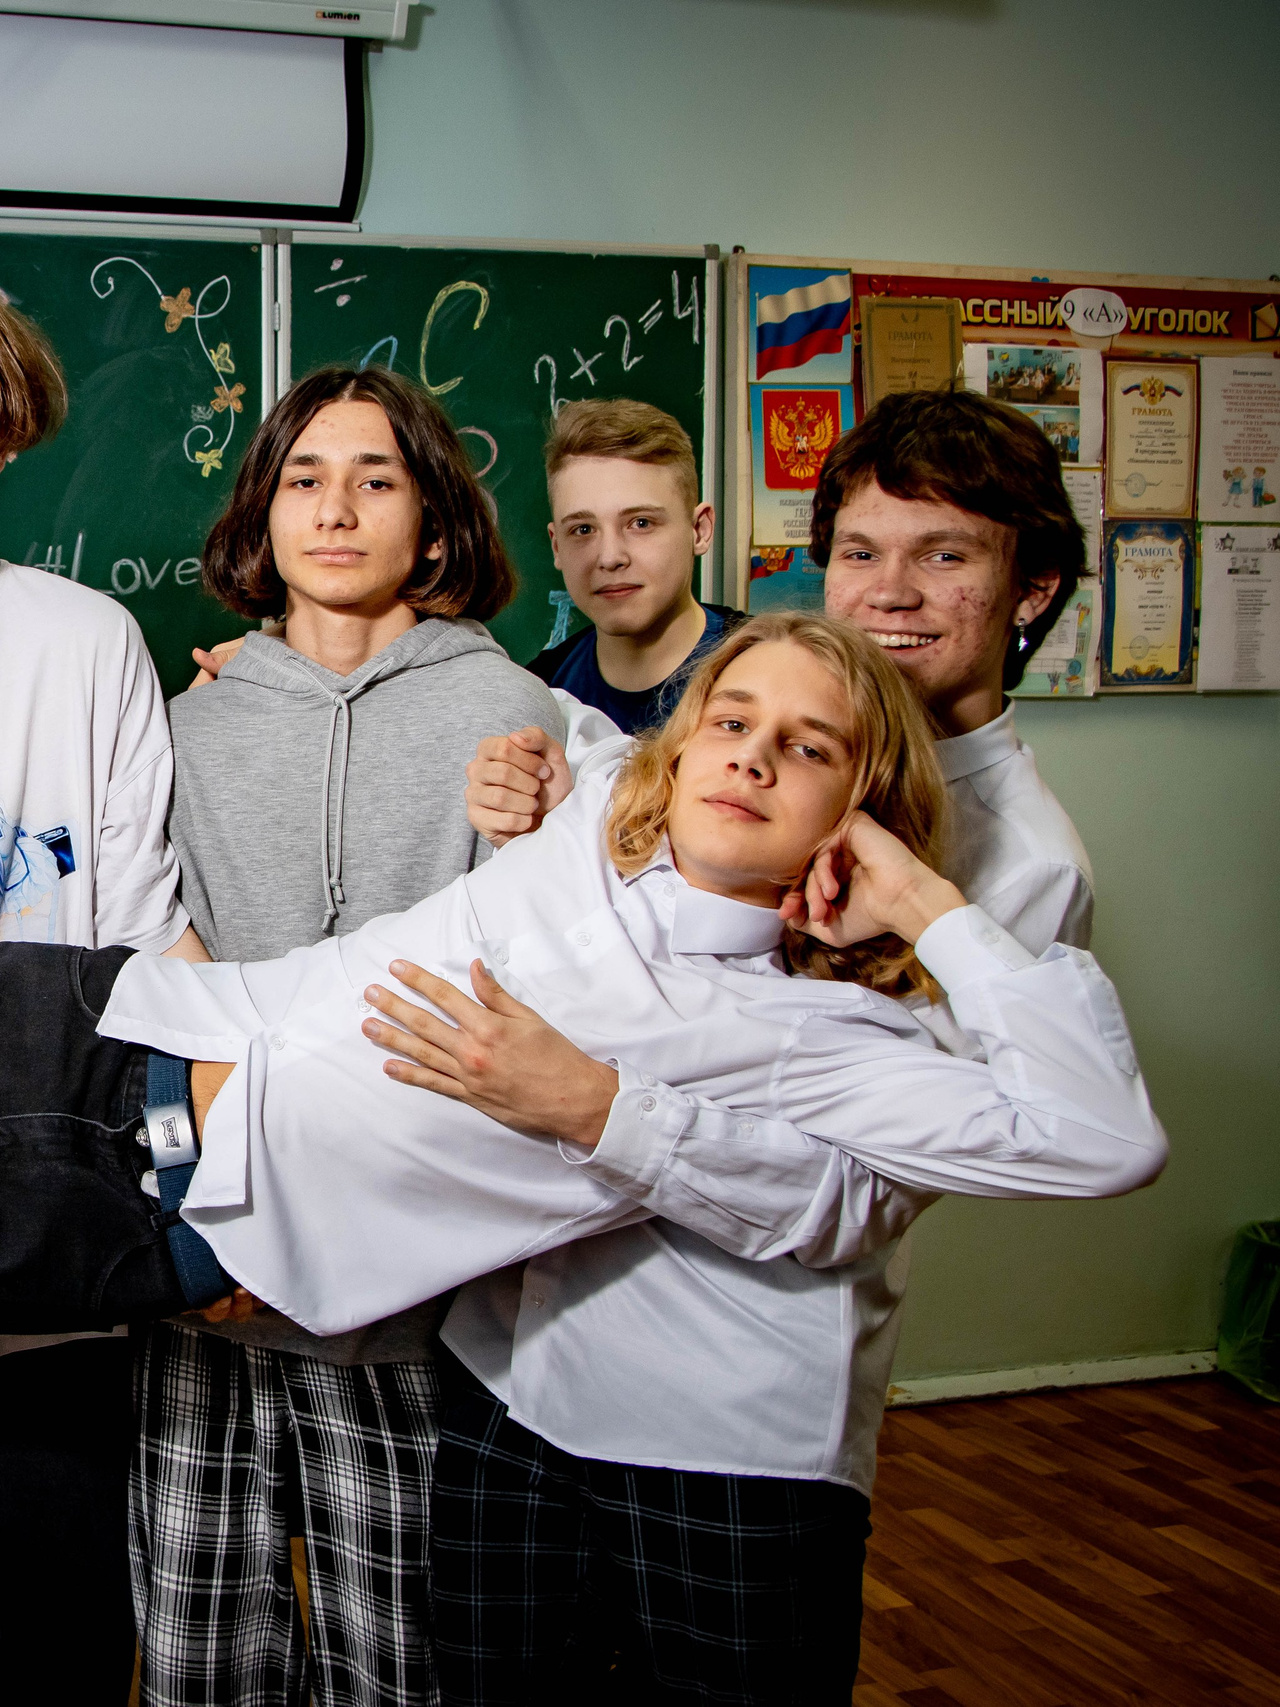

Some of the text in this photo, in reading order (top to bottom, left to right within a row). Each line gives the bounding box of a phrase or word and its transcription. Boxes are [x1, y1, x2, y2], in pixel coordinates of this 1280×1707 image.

[911, 295, 1231, 335] ССНЫЙ УГОЛОК
[1063, 299, 1075, 321] 9
[888, 331, 933, 342] ГРАМОТА
[1131, 407, 1173, 417] ГРАМОТА
[1124, 547, 1173, 557] ГРАМОТА
